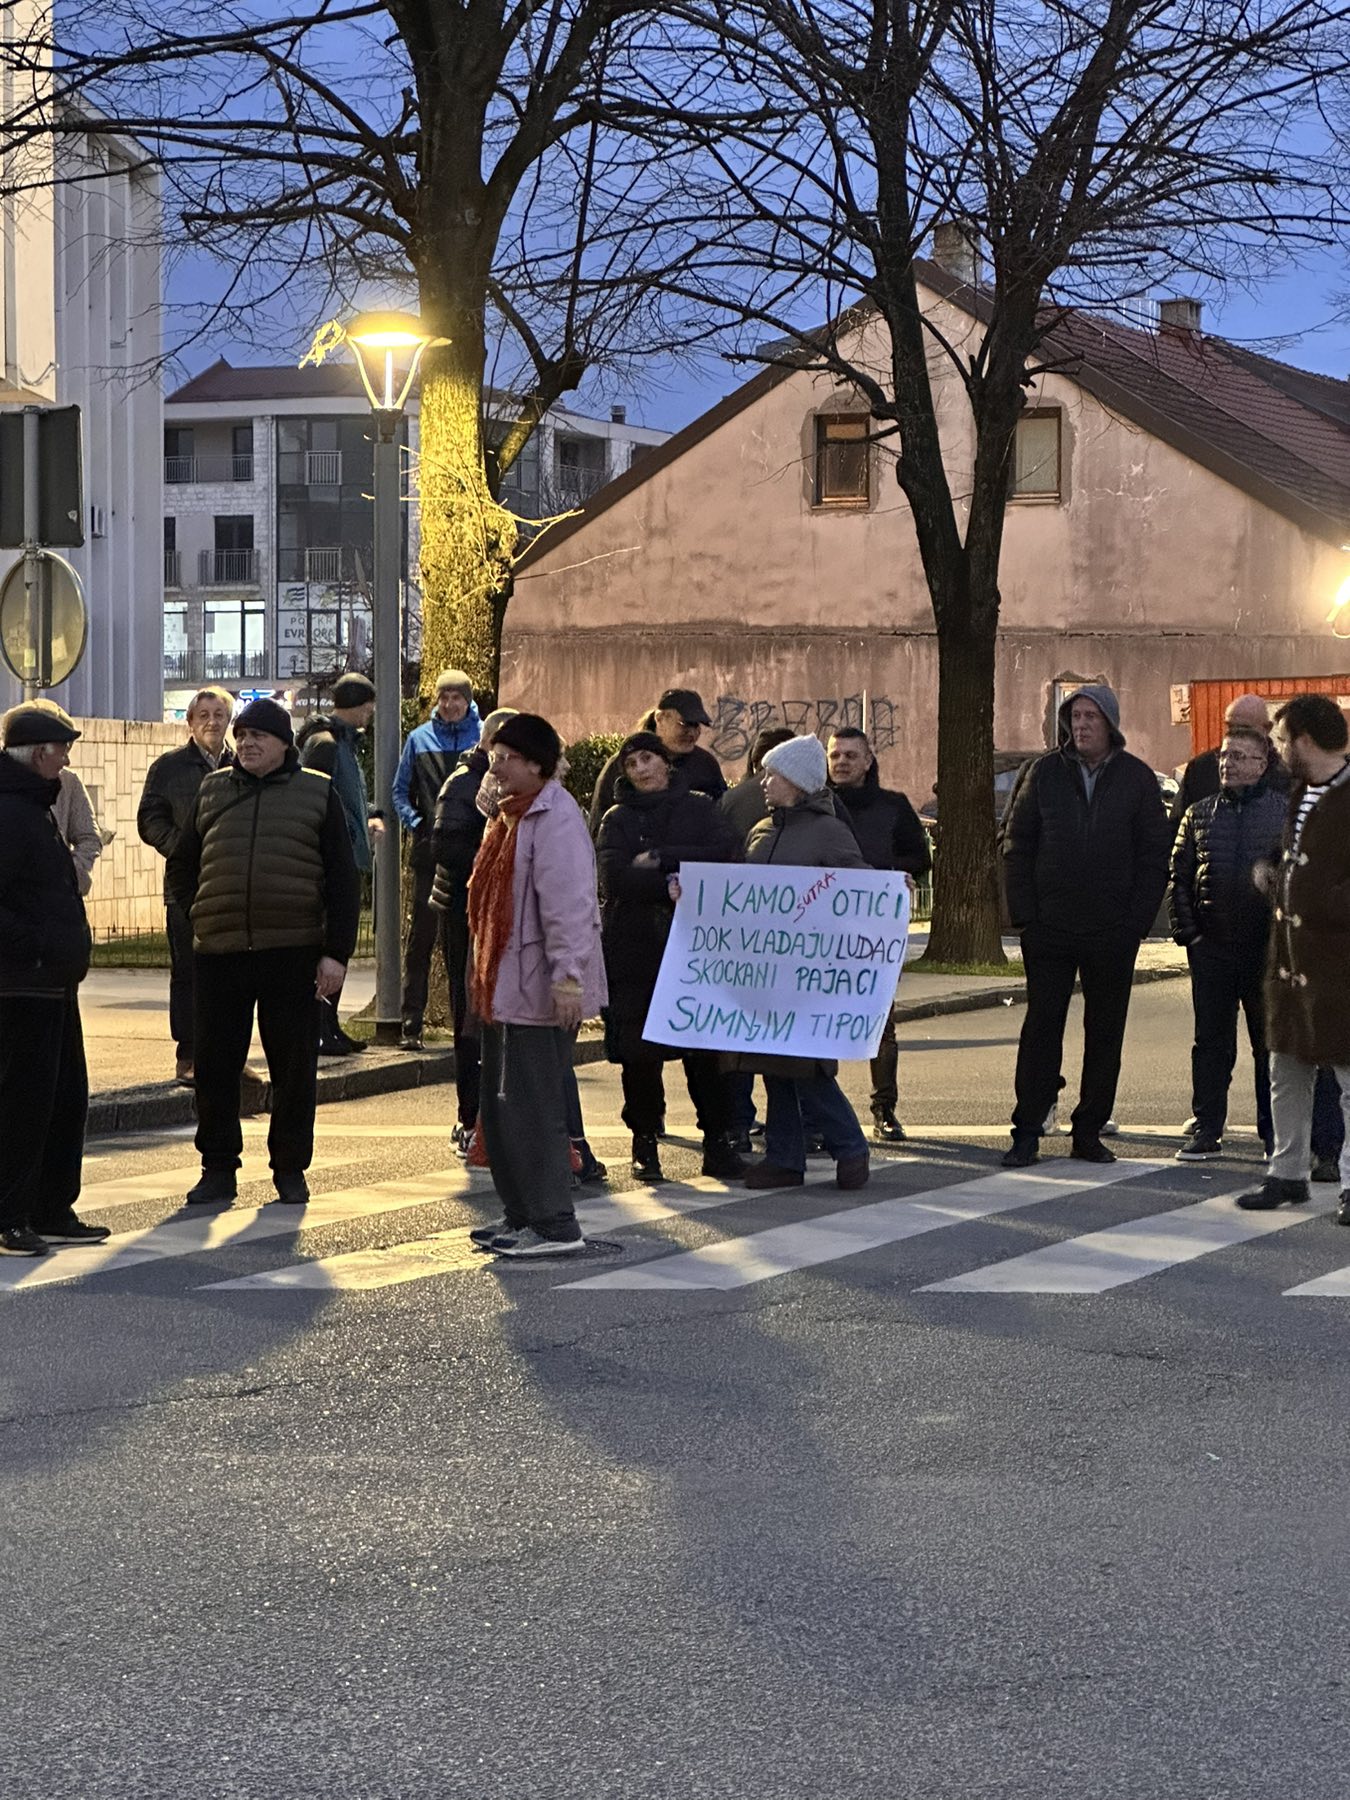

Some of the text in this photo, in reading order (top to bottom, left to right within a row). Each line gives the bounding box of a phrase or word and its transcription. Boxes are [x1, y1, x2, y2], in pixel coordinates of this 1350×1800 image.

[696, 871, 903, 923] I KAMO SUTRA OTIĆI
[687, 926, 906, 964] DOK VLADAJU LUDACI
[680, 958, 878, 995] SKOCKANI PAJACI
[668, 995, 886, 1042] SUMNJIVI TIPOVI
